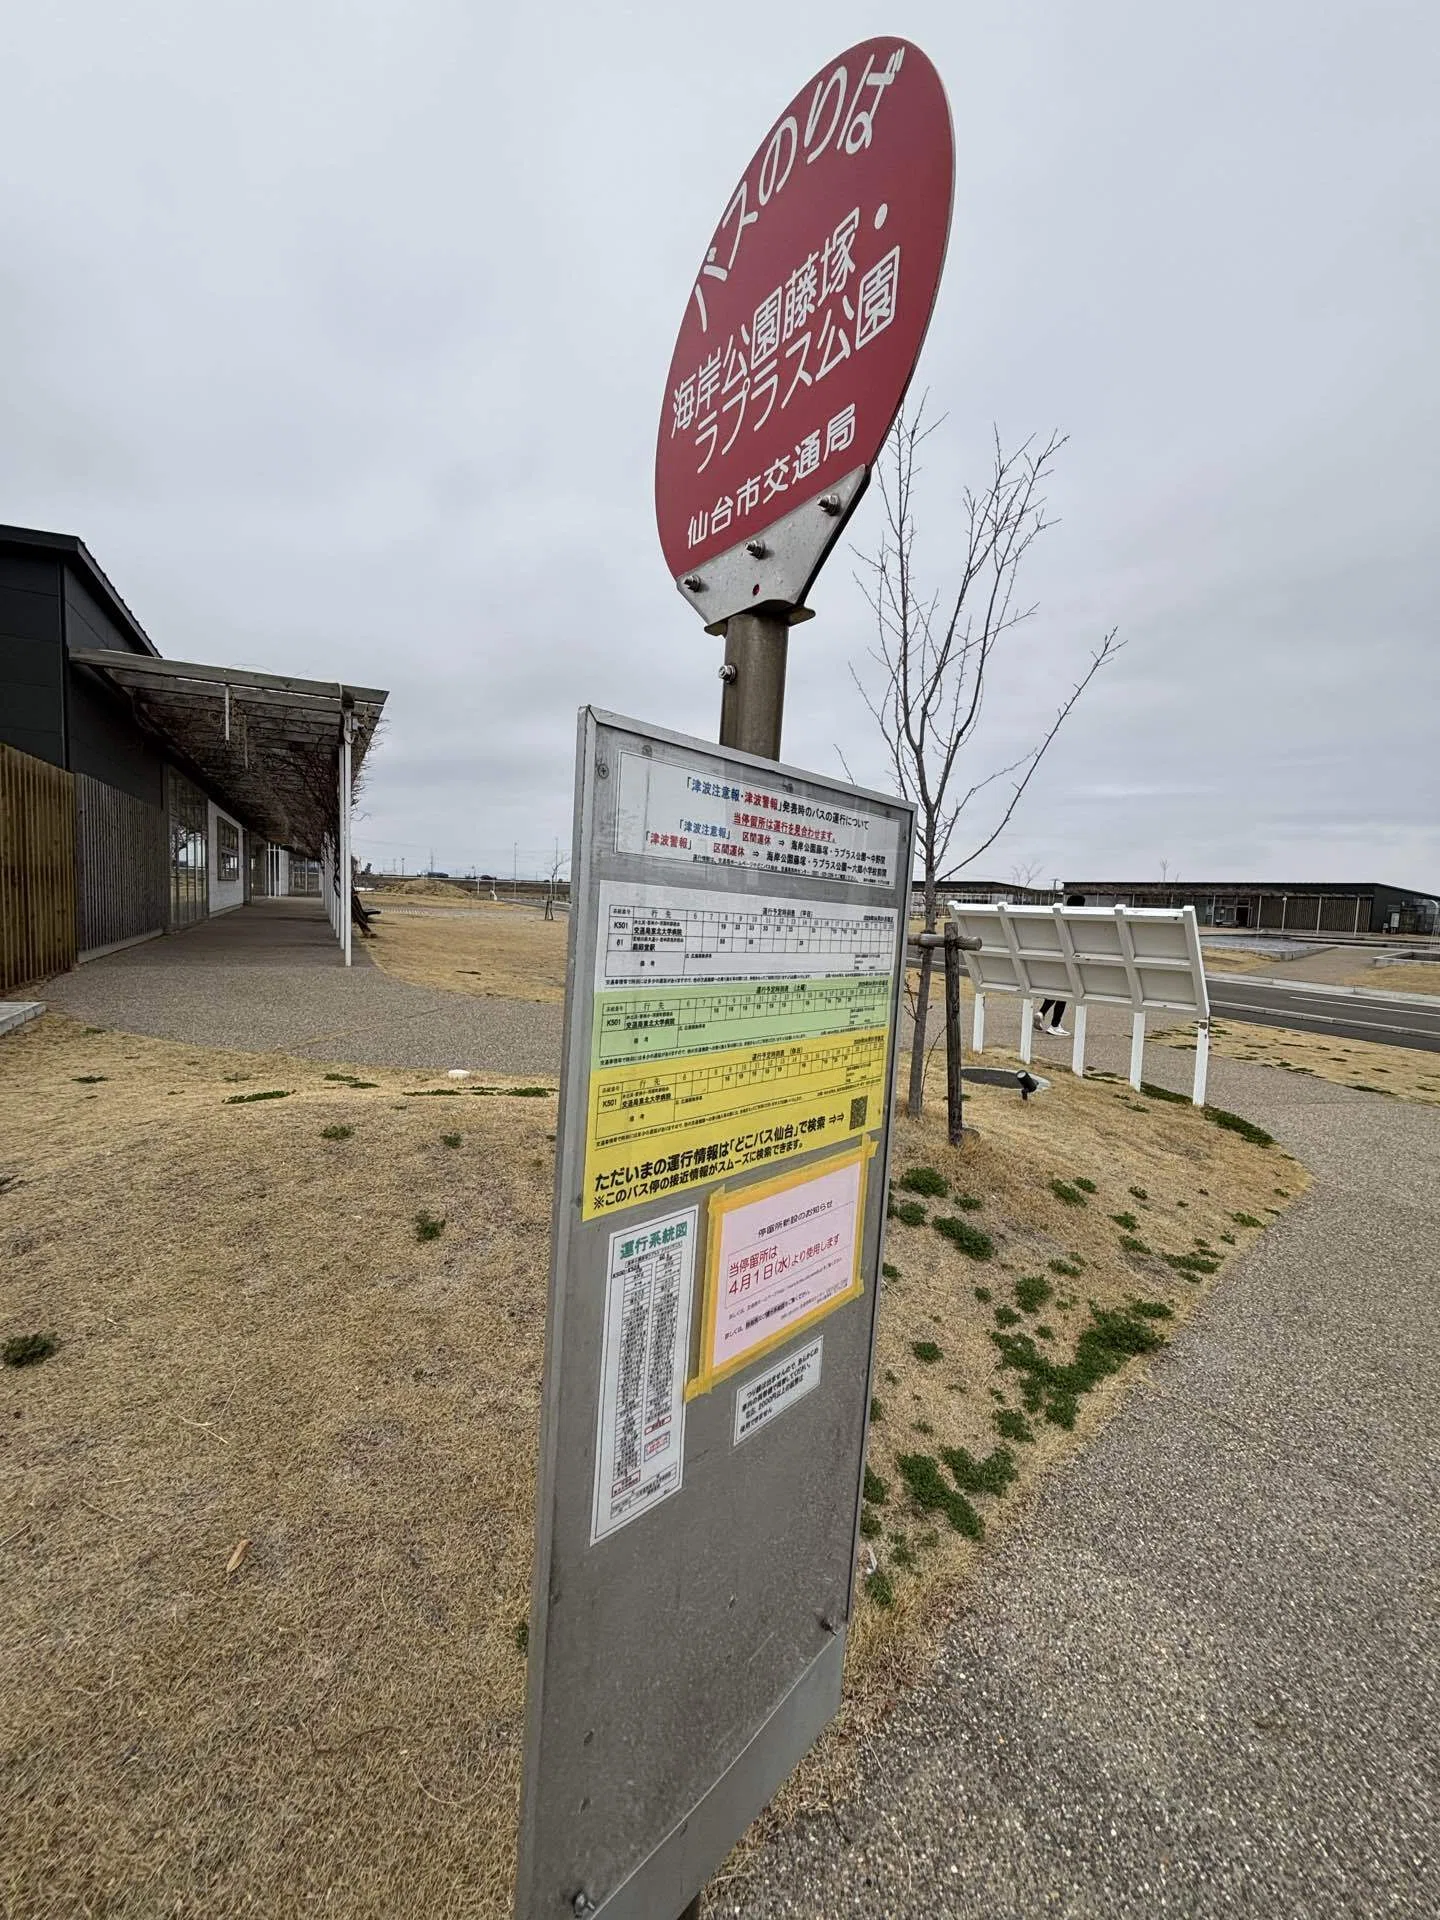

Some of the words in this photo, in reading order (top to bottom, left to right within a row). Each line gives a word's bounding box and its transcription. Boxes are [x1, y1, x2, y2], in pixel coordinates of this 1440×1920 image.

[692, 45, 905, 331] バスのりば
[696, 246, 900, 474] ラプラス公園
[688, 403, 856, 550] 仙台市交通局
[714, 842, 744, 857] 区間運休
[743, 831, 771, 846] 区間運休
[620, 1221, 688, 1260] 運行系統図
[730, 1245, 778, 1278] 当停留所は
